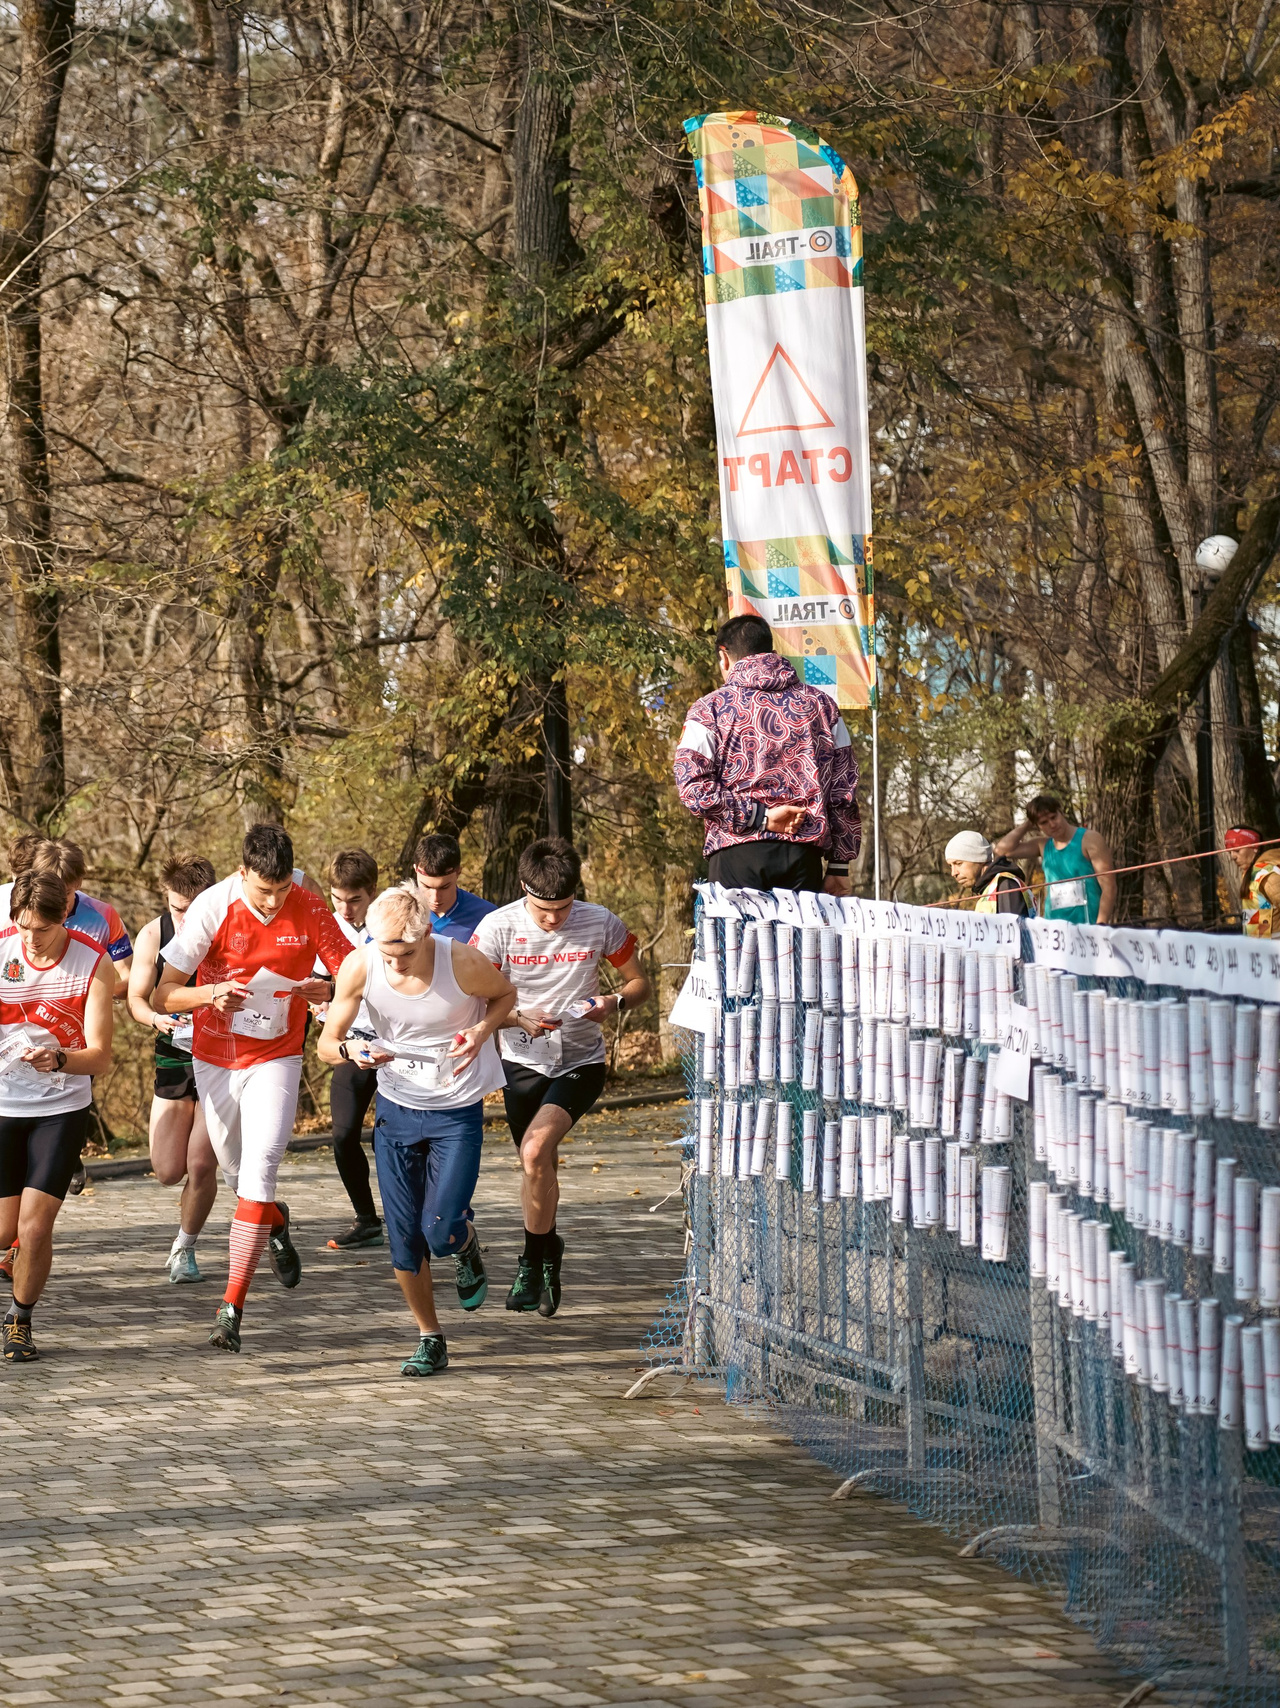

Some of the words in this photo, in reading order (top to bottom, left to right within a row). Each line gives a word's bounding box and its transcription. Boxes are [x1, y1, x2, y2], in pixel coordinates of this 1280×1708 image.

[851, 906, 857, 923] 8
[869, 909, 876, 927] 9
[886, 911, 897, 929] 10
[904, 913, 913, 932] 11
[936, 918, 946, 937] 13
[956, 921, 966, 940] 14
[975, 922, 985, 942] 15
[1007, 922, 1016, 943] 17
[506, 954, 549, 966] NORD
[553, 949, 596, 963] WEST
[35, 1004, 60, 1024] Run
[545, 1041, 550, 1049] 1
[436, 1064, 441, 1073] 1
